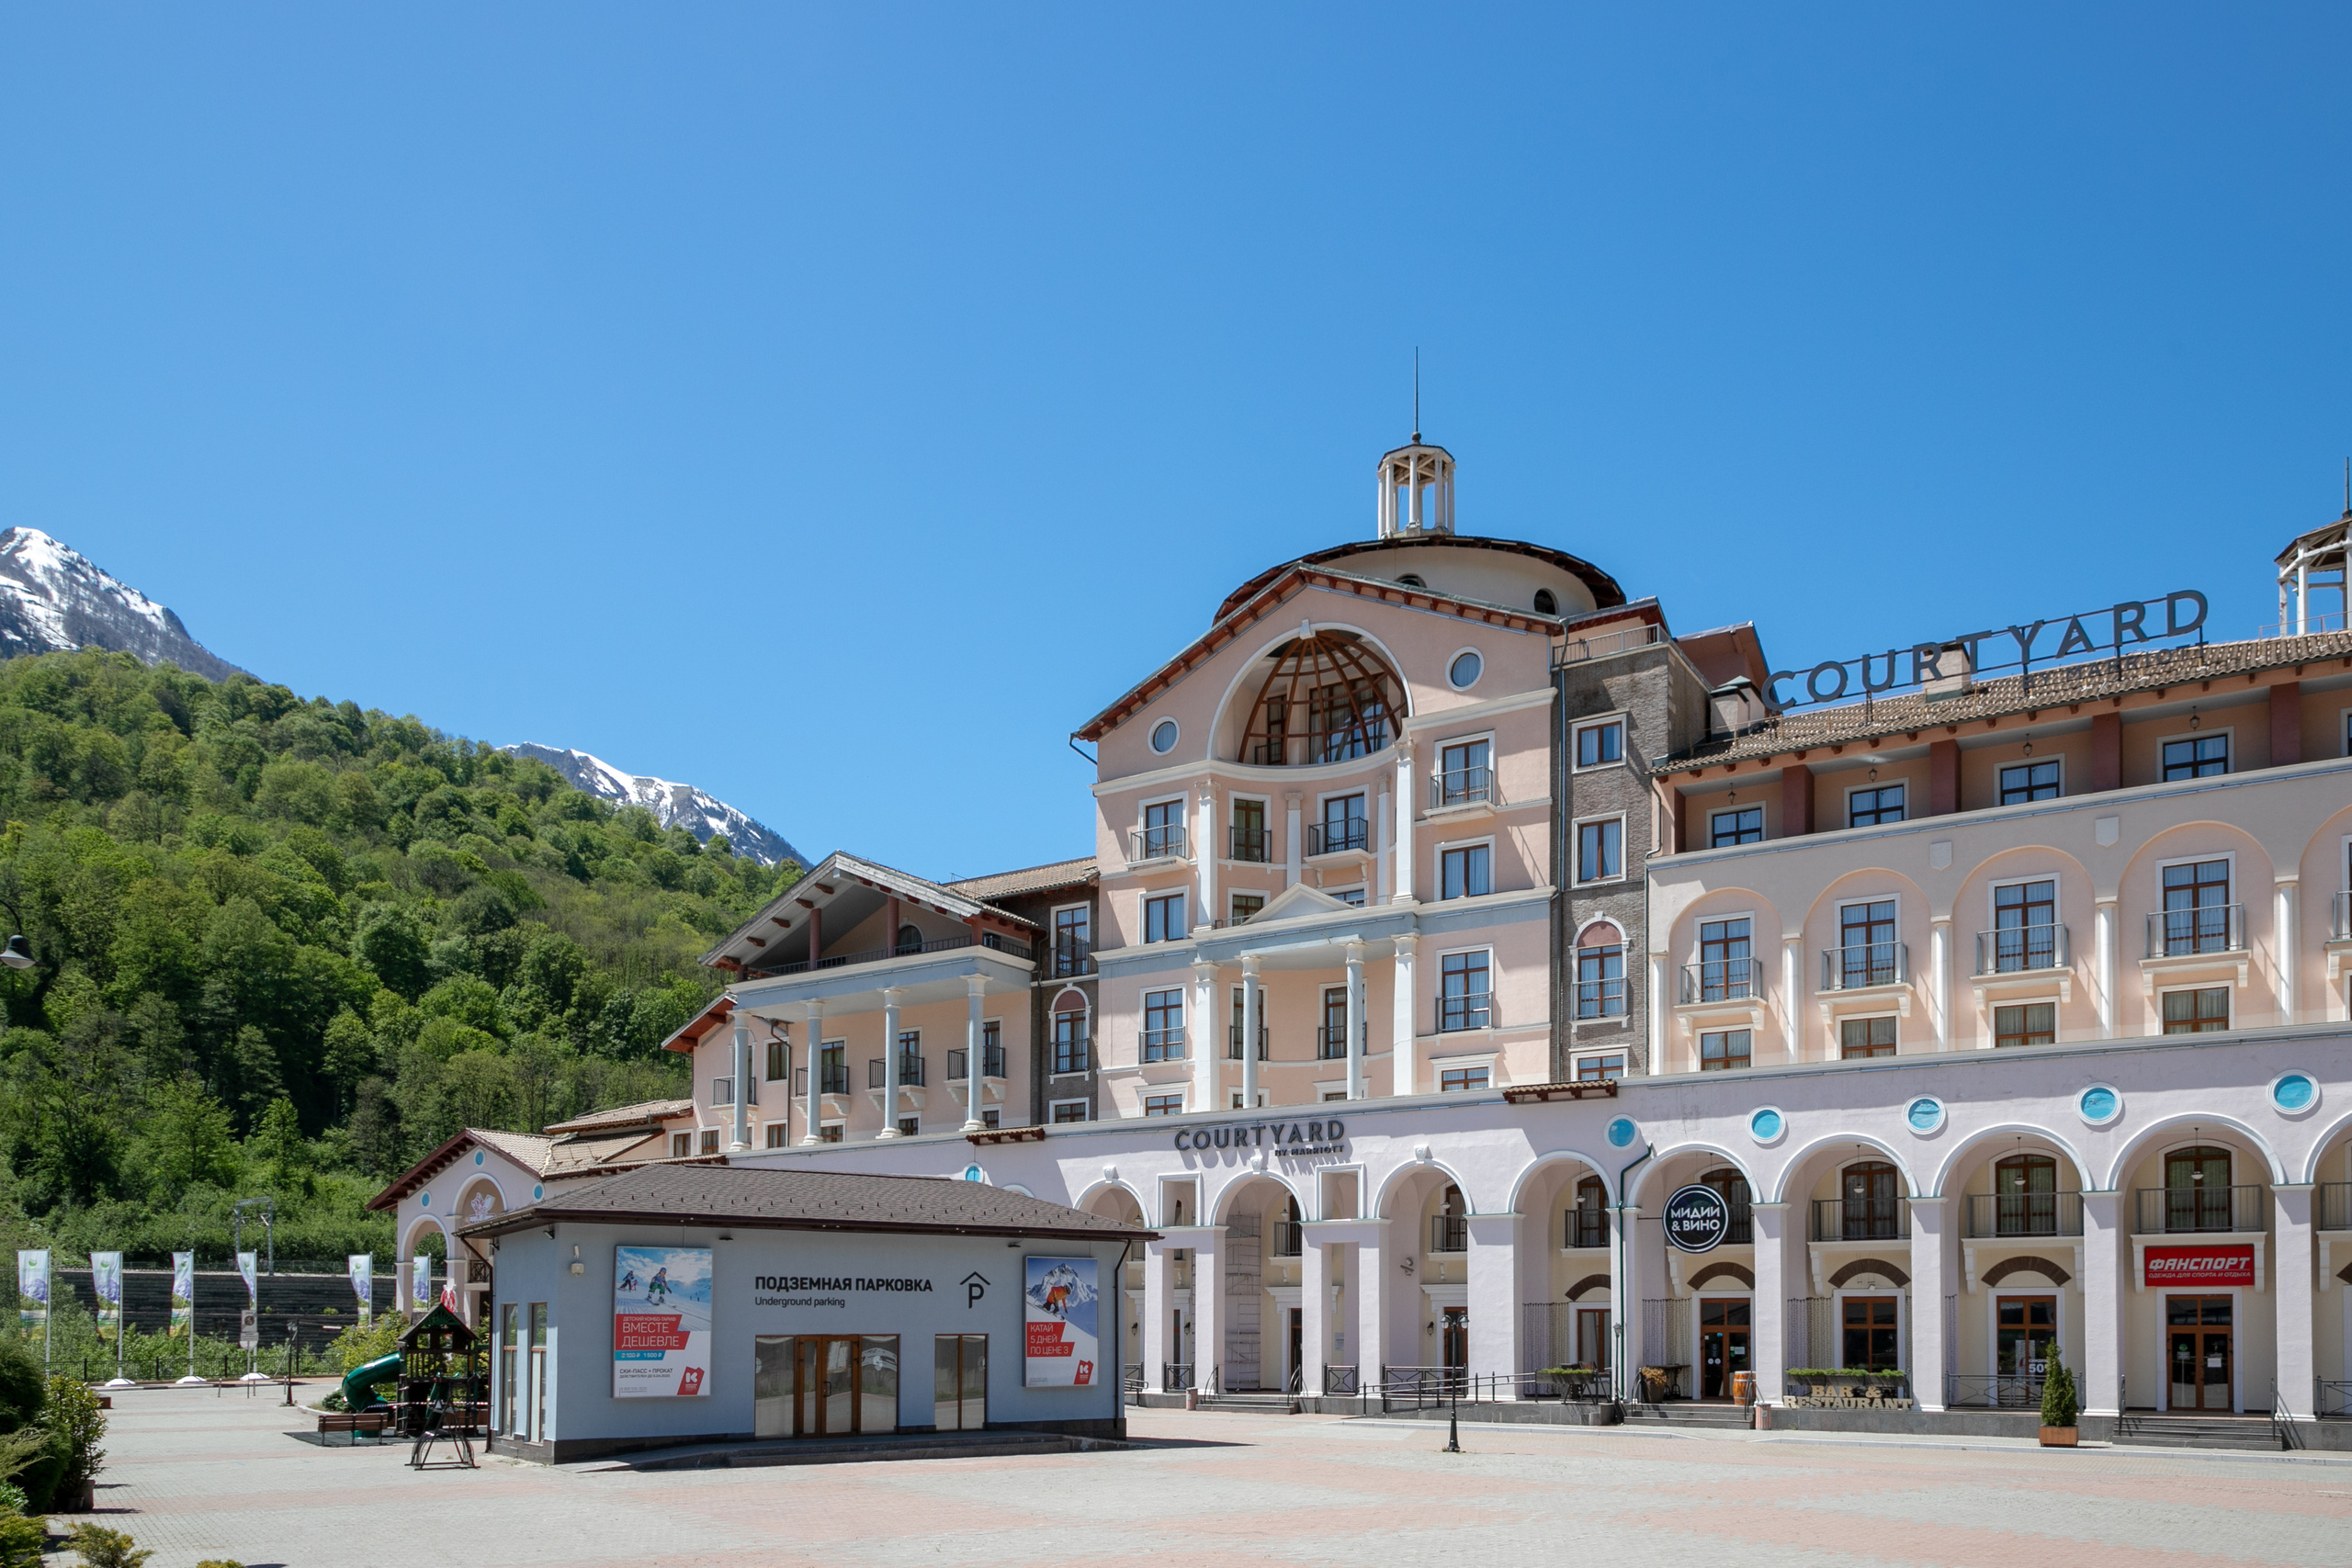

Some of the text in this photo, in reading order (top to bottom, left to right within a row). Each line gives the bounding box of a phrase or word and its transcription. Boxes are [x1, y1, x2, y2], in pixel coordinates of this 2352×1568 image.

[1761, 589, 2209, 712] COURTYARD
[2022, 641, 2209, 689] BY MARRIOTT
[1174, 1120, 1345, 1151] COURTYARD
[1290, 1145, 1345, 1156] MARRIOTT
[1671, 1206, 1720, 1219] МИДИИ
[1672, 1219, 1720, 1231] & ВИНО
[2148, 1257, 2250, 1270] ФАНСПОРТ
[755, 1276, 933, 1292] ПОДЗЕМНАЯ ПАРКОВКА
[755, 1296, 846, 1309] Underground parking
[622, 1322, 669, 1333] ВМЕСТЕ
[1030, 1323, 1053, 1332] КАТАЙ
[622, 1336, 679, 1348] ДЕШЕВЛЕ
[1030, 1334, 1057, 1344] 5 ДНЕЙ
[1042, 1346, 1062, 1355] ЦЕНЕ
[1811, 1385, 1882, 1398] BAR &
[1783, 1396, 1913, 1409] RESTAURANT
